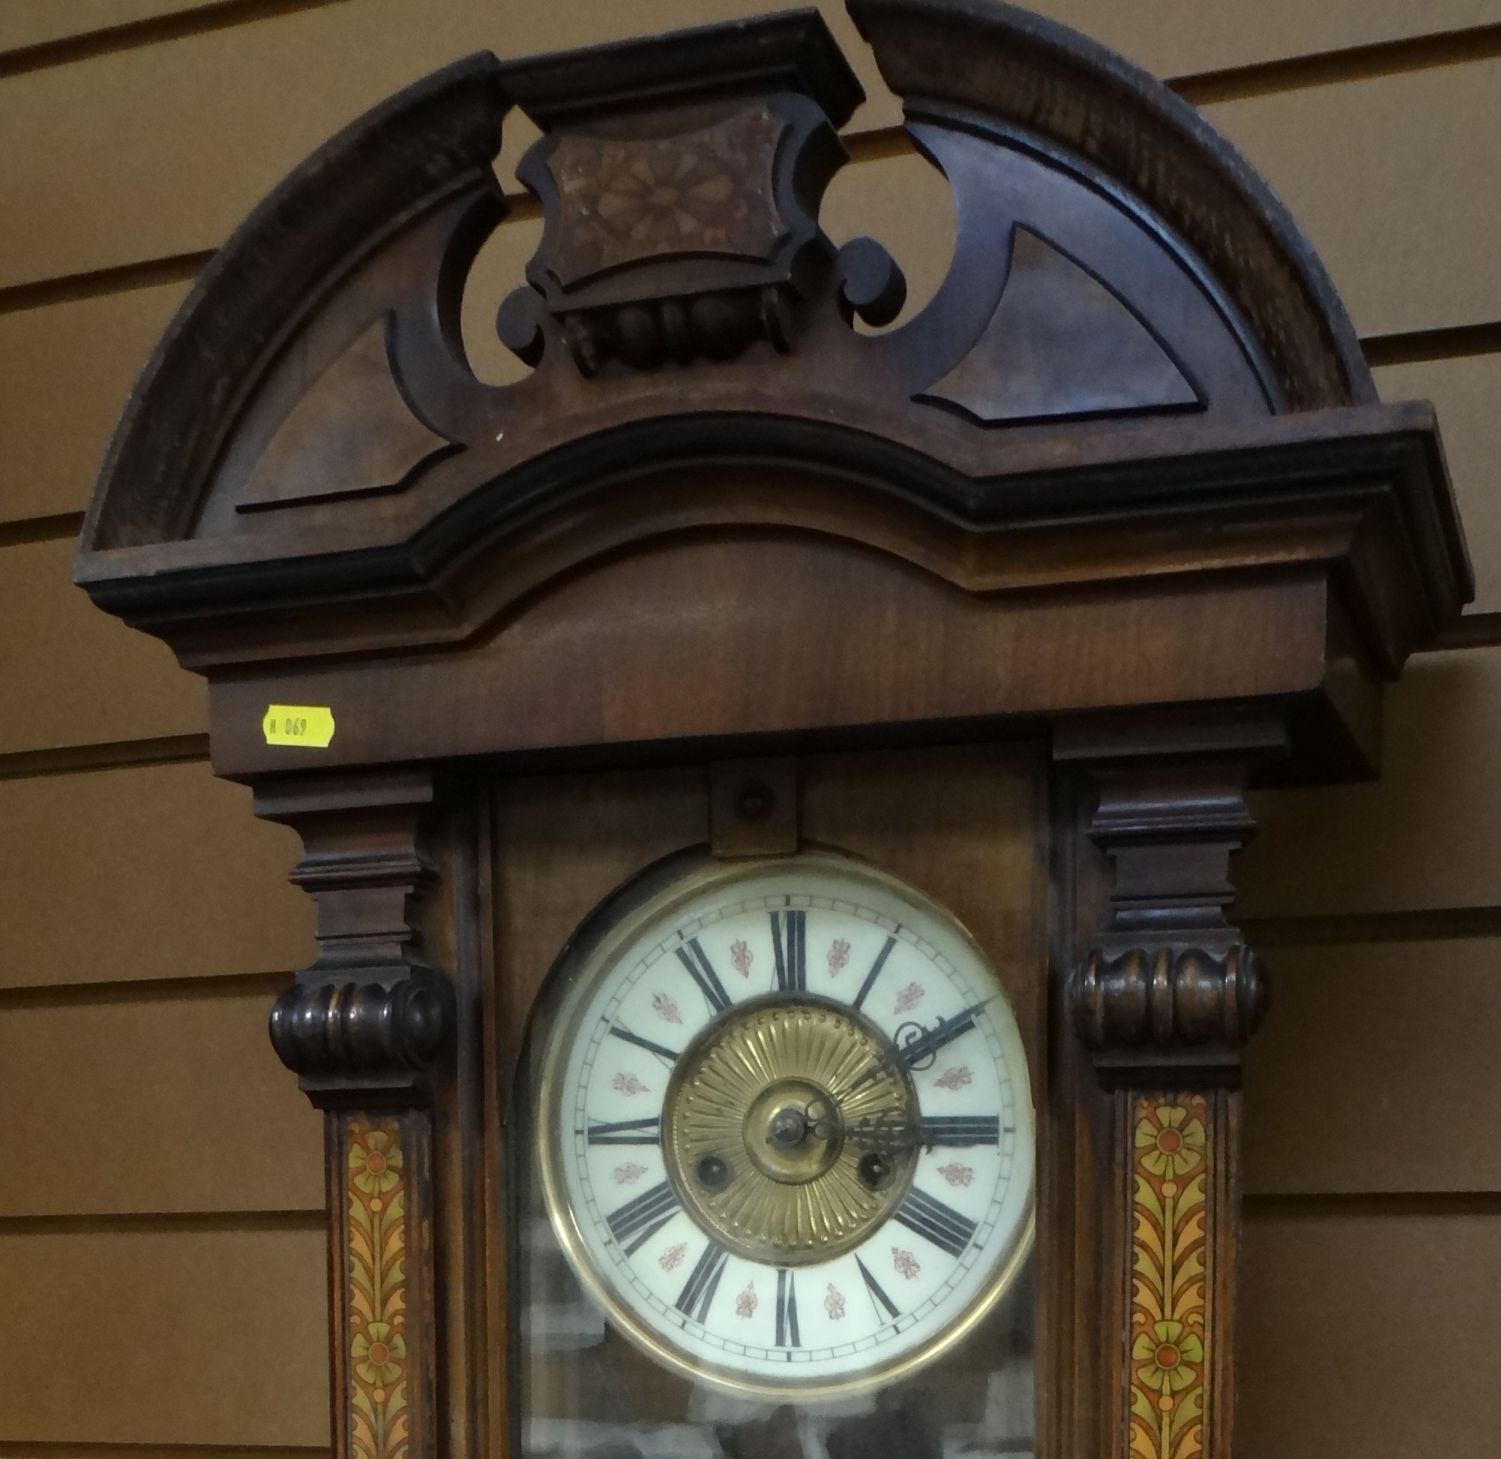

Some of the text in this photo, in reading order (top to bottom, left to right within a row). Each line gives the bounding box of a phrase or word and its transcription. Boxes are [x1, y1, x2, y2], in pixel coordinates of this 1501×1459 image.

[283, 716, 307, 736] 069
[674, 936, 734, 1017] XI
[768, 910, 806, 993] XII
[853, 935, 897, 1010] I
[607, 1016, 678, 1069] X
[588, 1113, 660, 1145] IX
[919, 1115, 999, 1145] III
[606, 1179, 683, 1258] VIII
[893, 1184, 979, 1259] IIII
[674, 1238, 730, 1326] VII
[774, 1269, 801, 1348] VI
[854, 1252, 902, 1326] V
